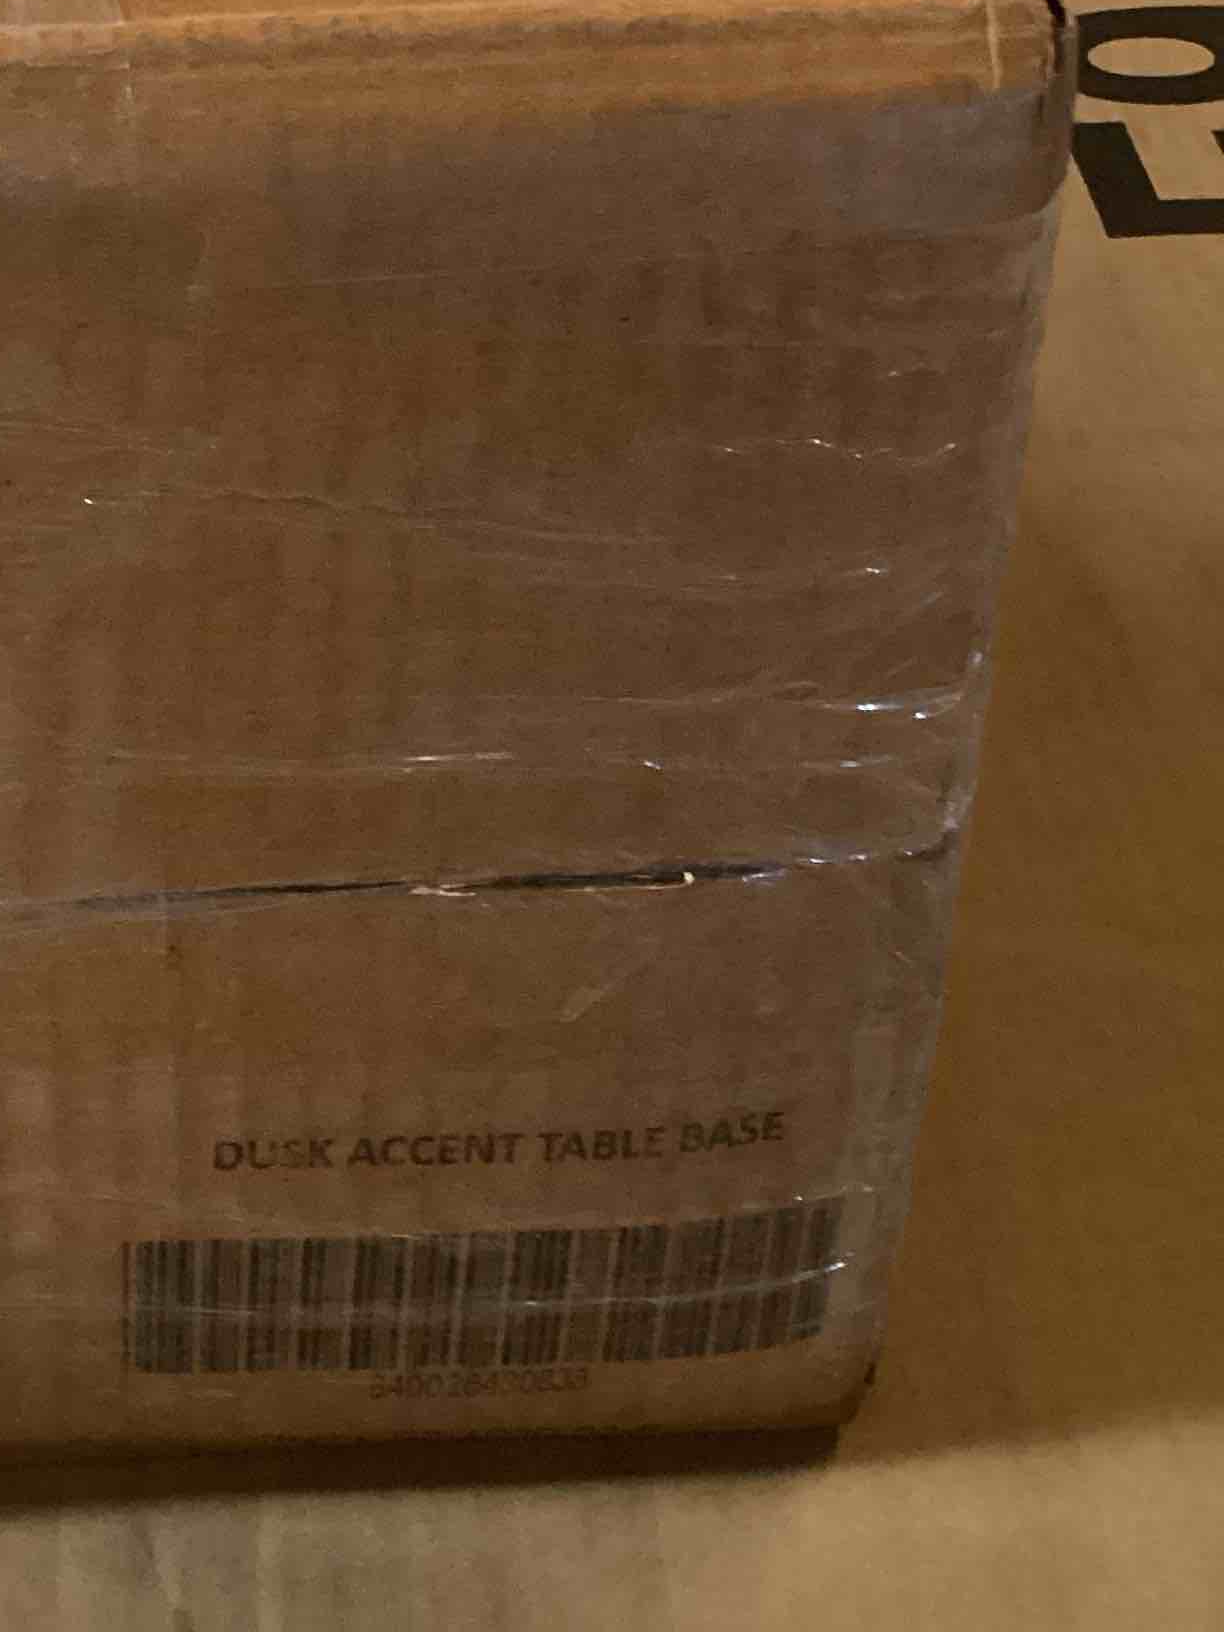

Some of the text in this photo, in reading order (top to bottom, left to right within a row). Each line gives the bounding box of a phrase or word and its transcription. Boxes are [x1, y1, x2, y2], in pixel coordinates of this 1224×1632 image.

[213, 1111, 785, 1172] DUSK ACCENT TABLE BASE
